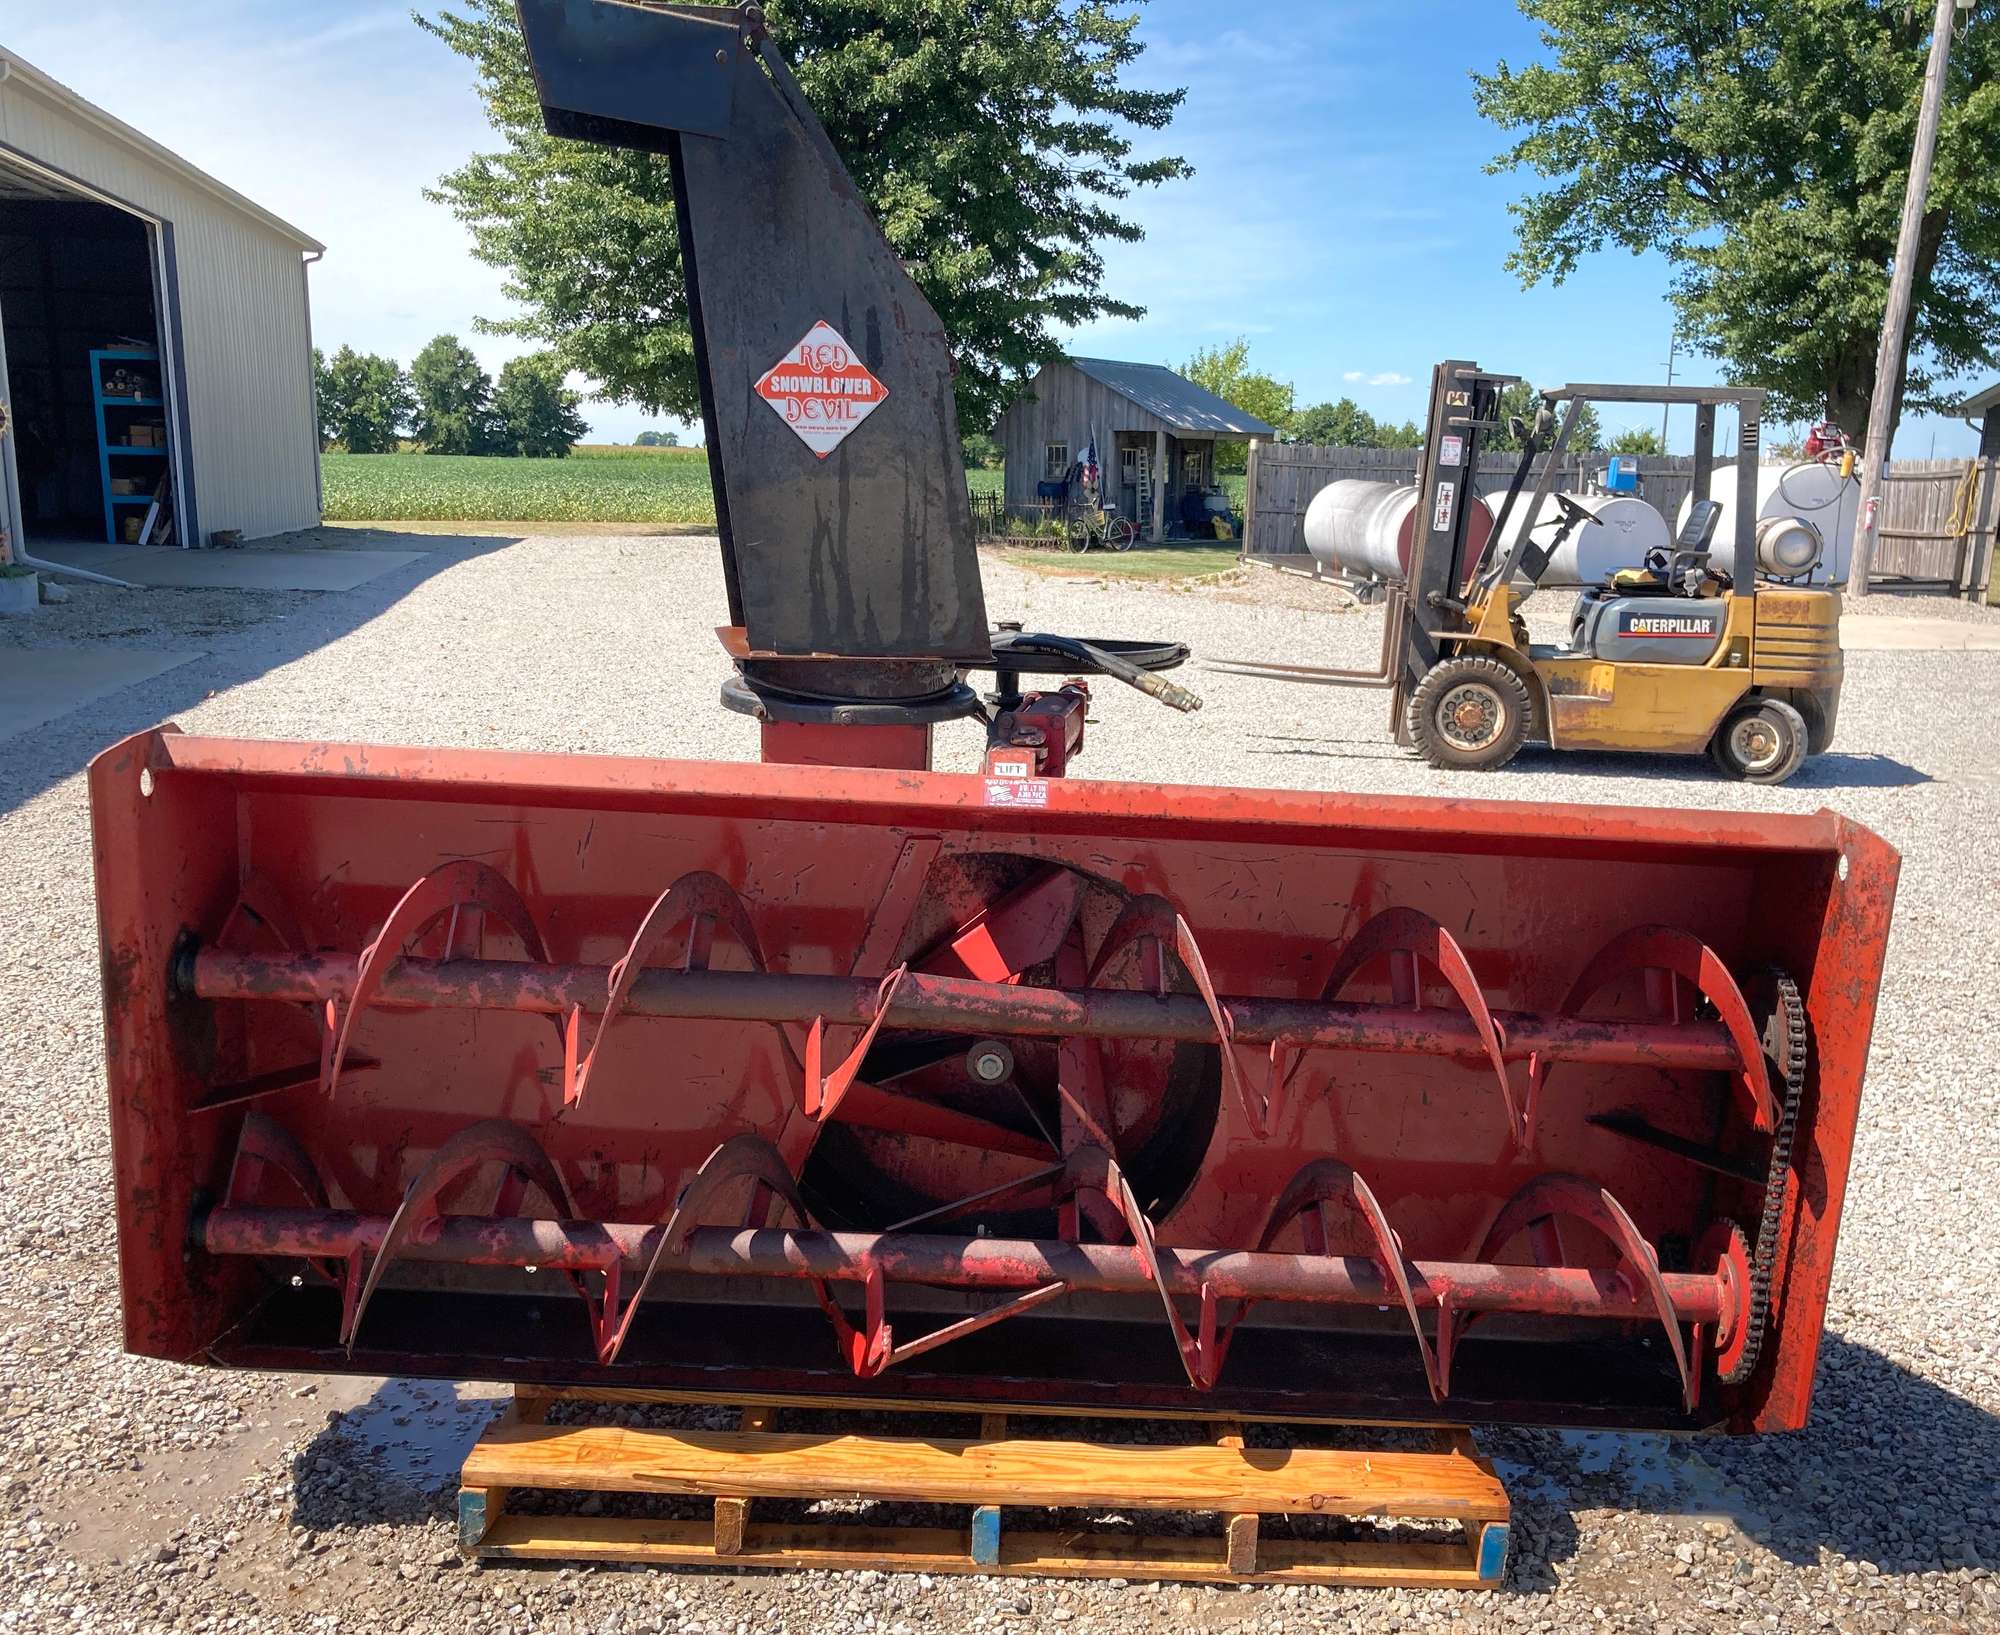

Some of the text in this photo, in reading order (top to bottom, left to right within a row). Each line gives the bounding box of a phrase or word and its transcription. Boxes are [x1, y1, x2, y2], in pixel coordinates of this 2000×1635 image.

[800, 345, 848, 372] RED
[771, 376, 872, 395] SNOWBLOWER
[1446, 391, 1471, 407] CAT
[786, 397, 858, 422] DEVIL
[1630, 618, 1710, 634] CATERPILLAR
